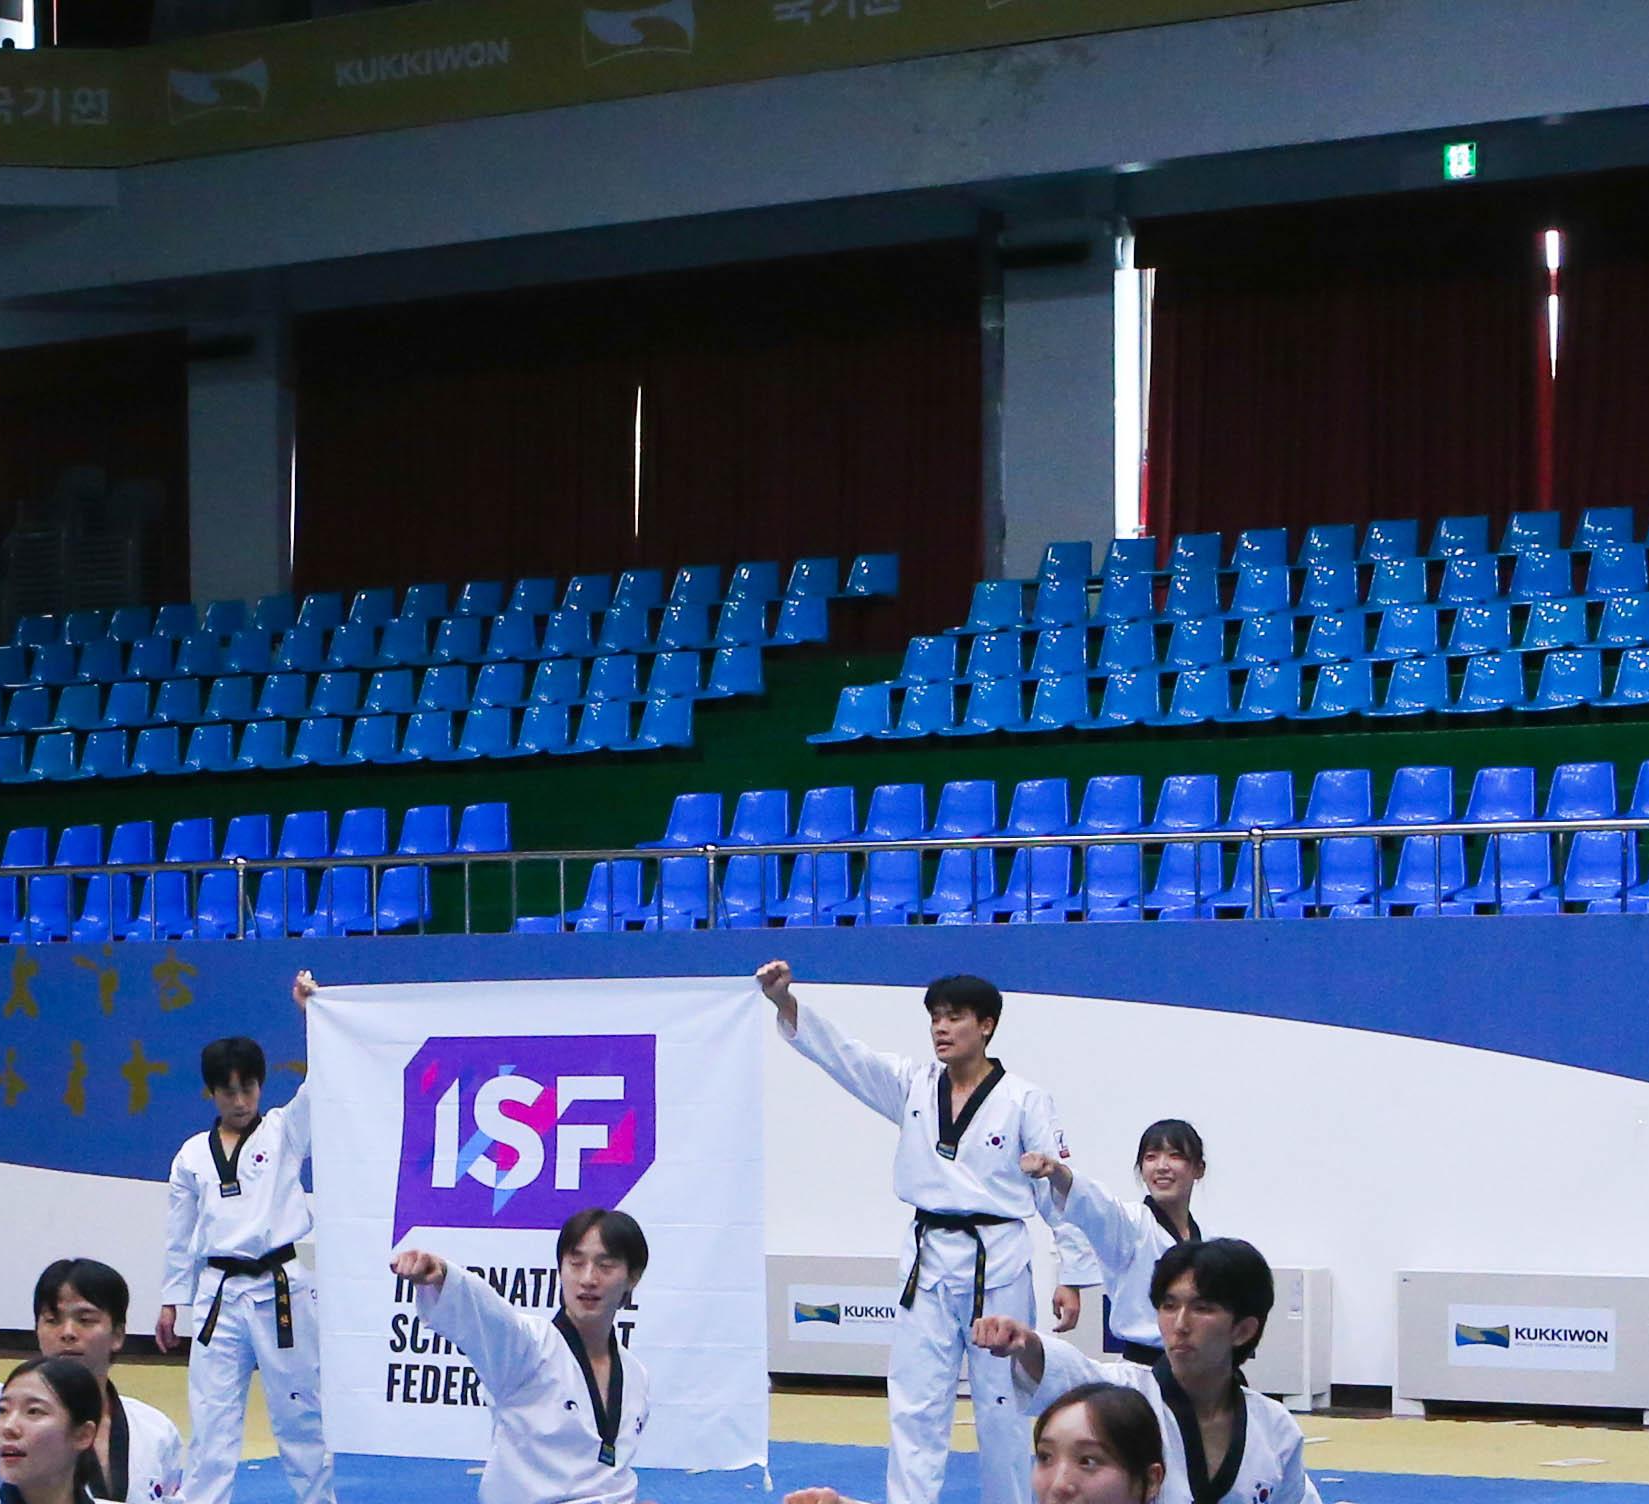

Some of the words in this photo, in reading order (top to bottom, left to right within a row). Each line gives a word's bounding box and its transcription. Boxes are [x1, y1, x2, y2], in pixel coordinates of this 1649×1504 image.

[336, 38, 510, 87] KUKKIWON
[431, 1074, 626, 1190] ISF
[1514, 1327, 1609, 1343] KUKKIWON
[386, 1363, 489, 1407] FEDER
